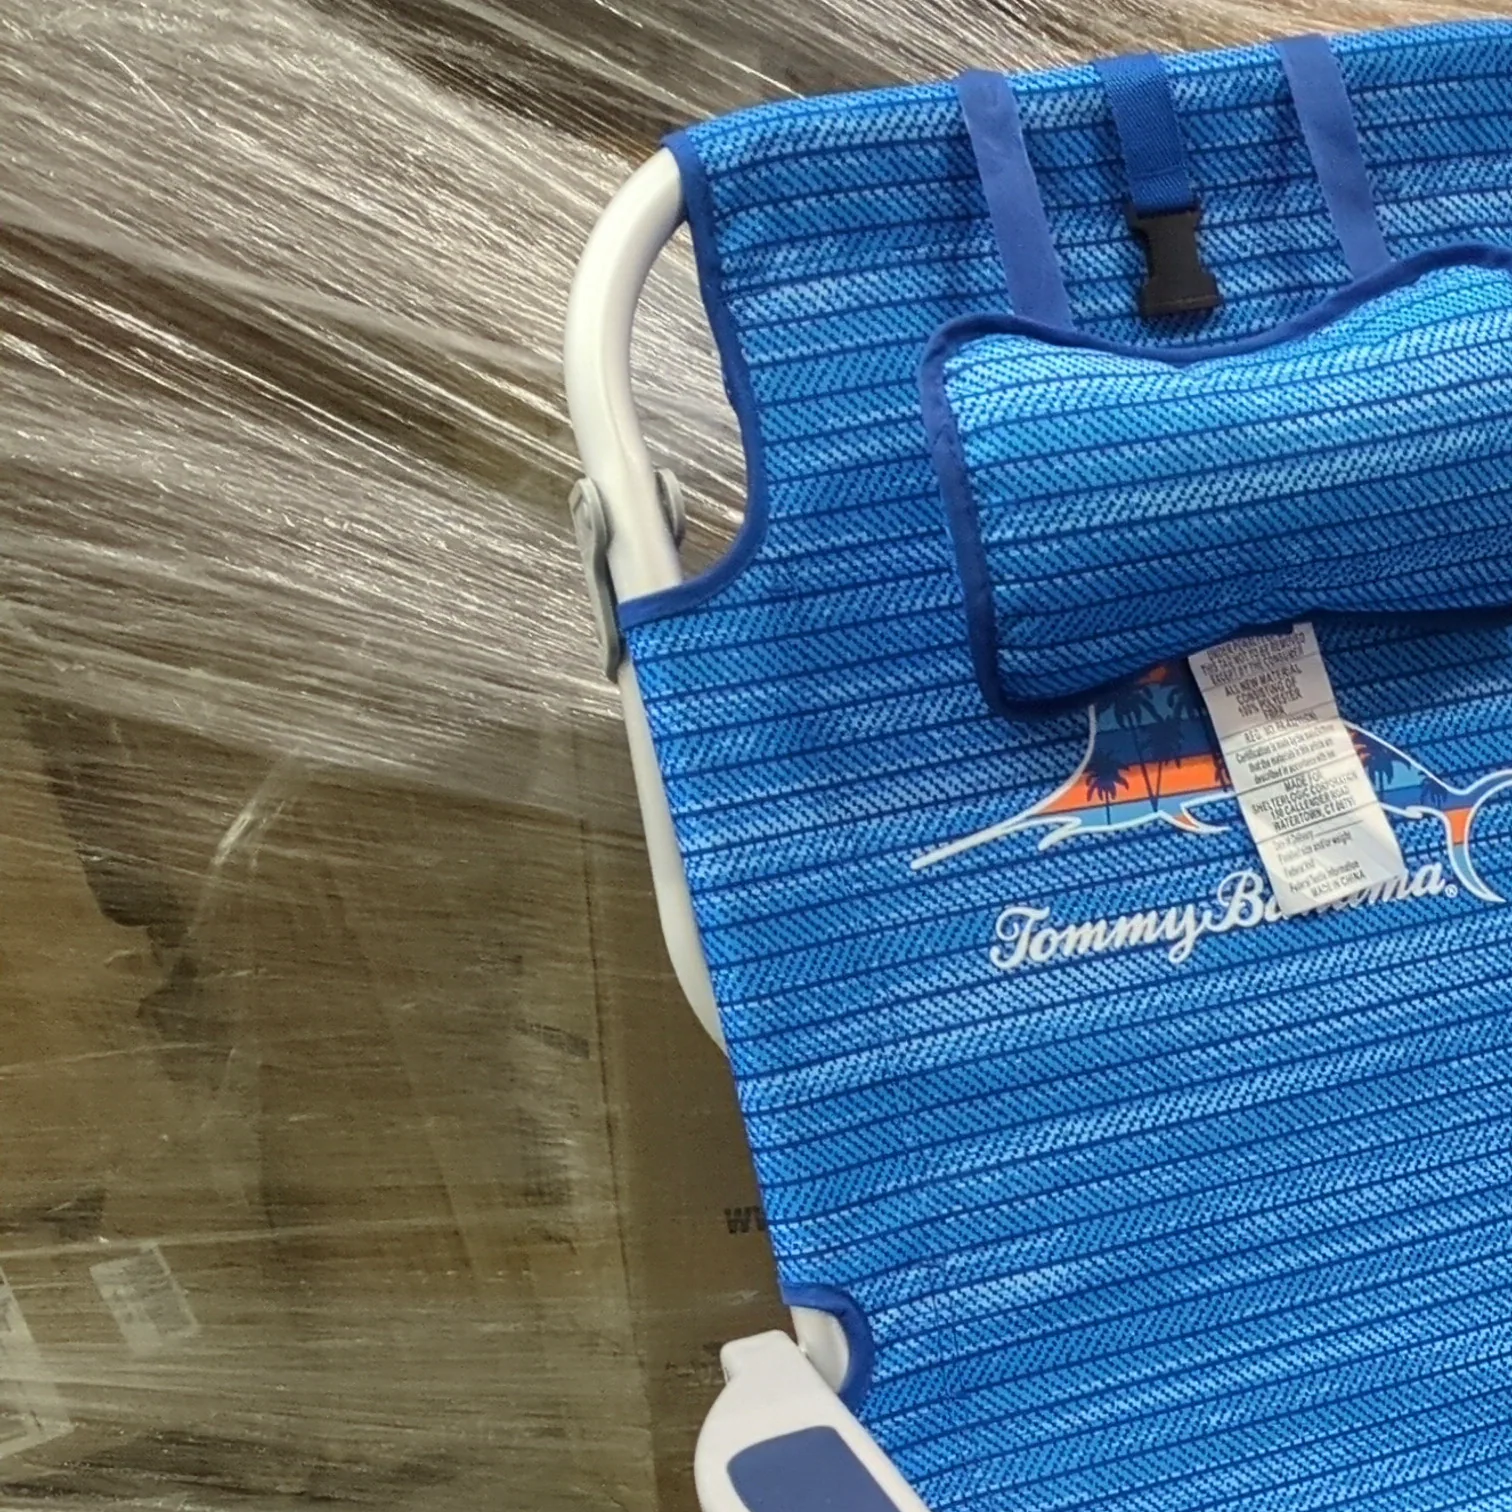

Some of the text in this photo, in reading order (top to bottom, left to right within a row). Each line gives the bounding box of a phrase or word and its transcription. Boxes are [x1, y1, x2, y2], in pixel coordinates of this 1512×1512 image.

[1239, 676, 1259, 691] NEW
[1258, 662, 1302, 685] MATERIAL
[1282, 774, 1308, 792] MADE
[1339, 869, 1366, 886] CHINA
[992, 863, 1445, 967] Tommy Bama
